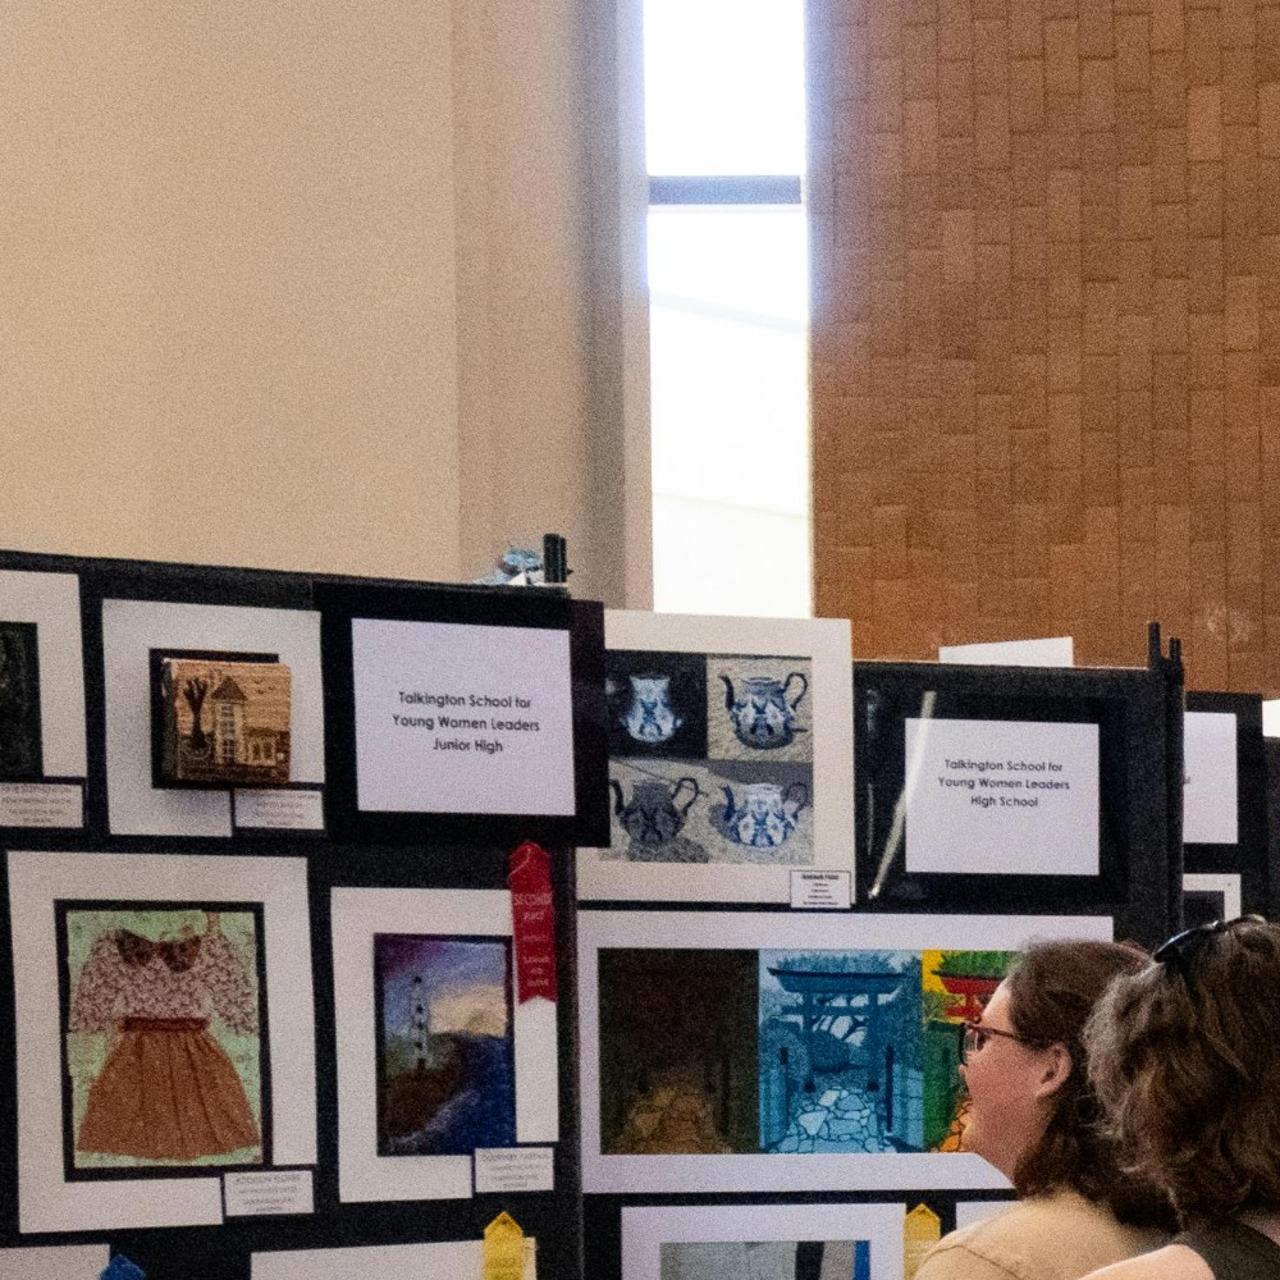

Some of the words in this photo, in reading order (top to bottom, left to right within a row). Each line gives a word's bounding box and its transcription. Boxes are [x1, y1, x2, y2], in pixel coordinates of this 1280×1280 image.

[398, 691, 466, 708] Talkington
[469, 694, 512, 708] School
[514, 697, 531, 708] for
[392, 715, 434, 730] Young
[437, 716, 487, 729] Women
[490, 718, 541, 731] Leaders
[432, 738, 470, 751] Junior
[474, 740, 504, 754] High
[944, 759, 1004, 772] Talkington
[1006, 761, 1046, 771] School
[1047, 762, 1063, 771] for
[938, 777, 975, 789] Young
[978, 778, 1023, 788] Women
[1025, 779, 1070, 790] Leaders
[970, 796, 996, 808] High
[999, 797, 1039, 807] School
